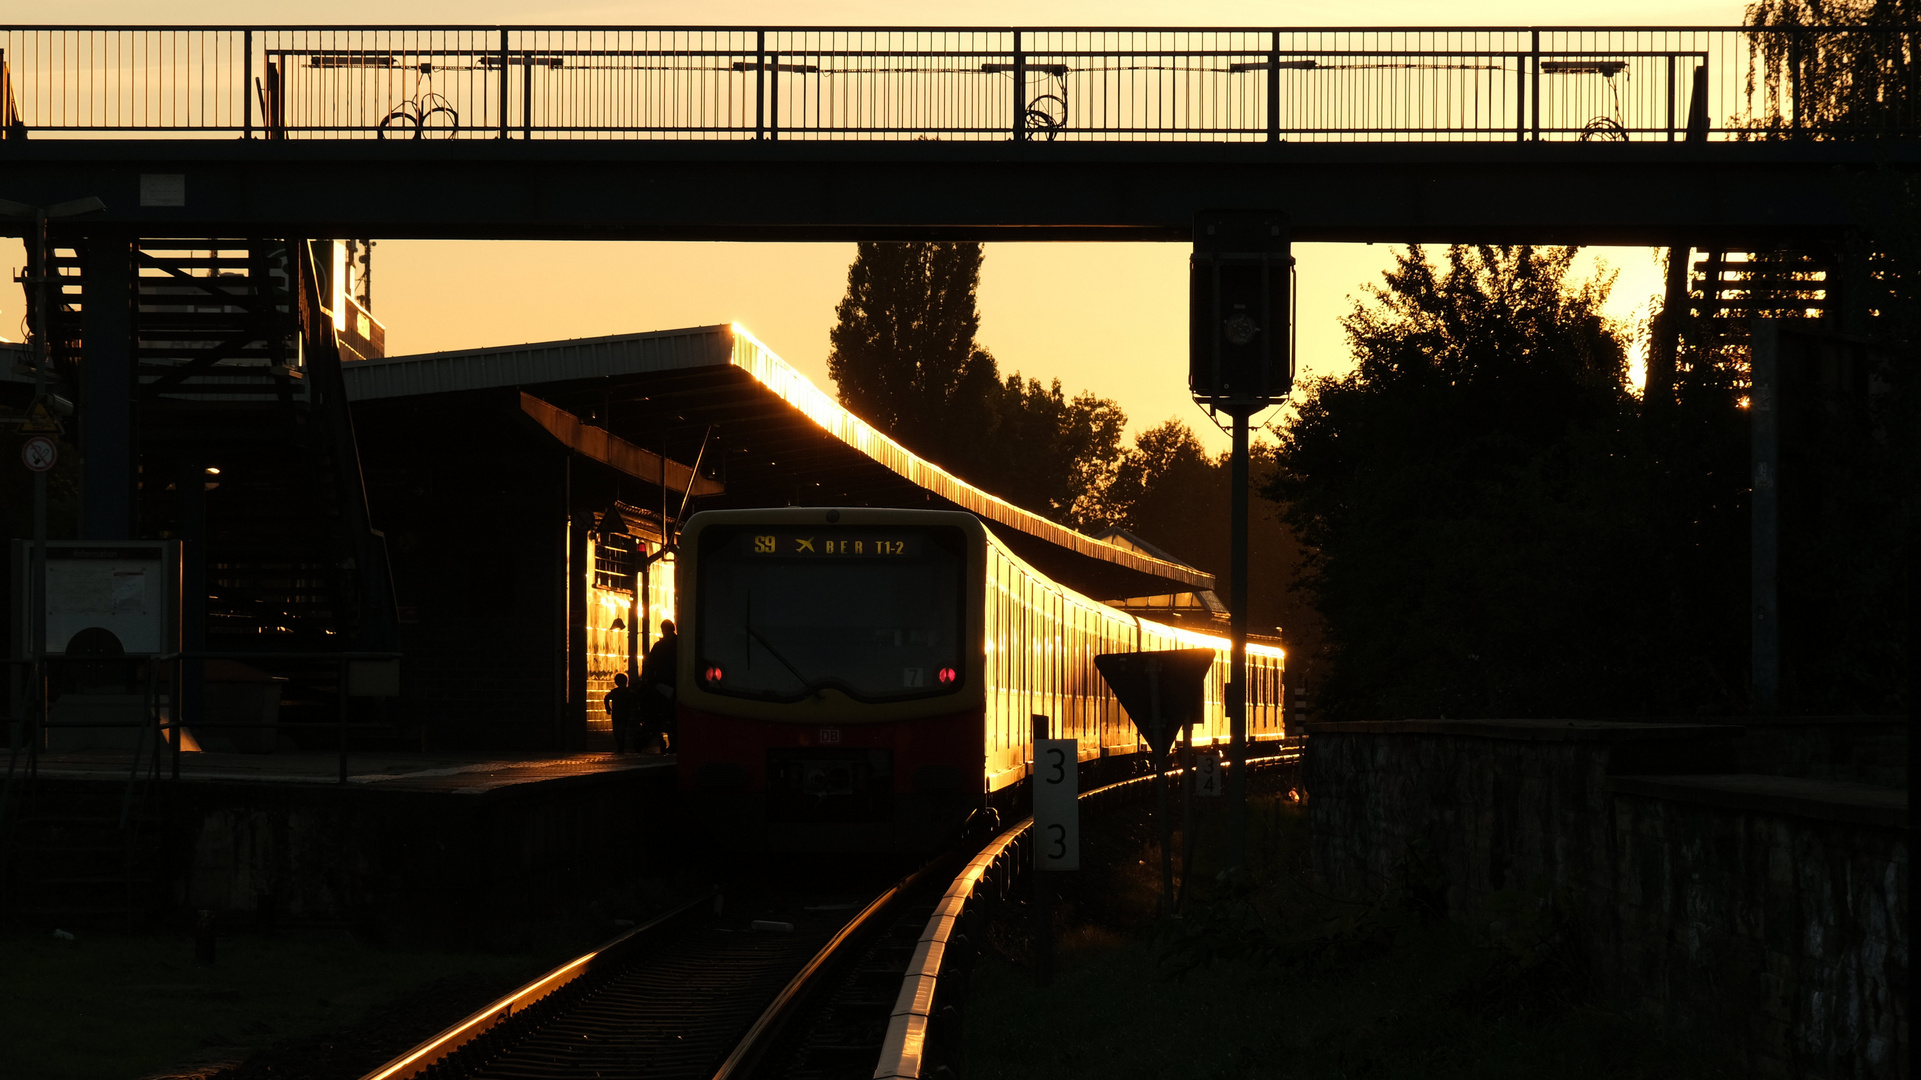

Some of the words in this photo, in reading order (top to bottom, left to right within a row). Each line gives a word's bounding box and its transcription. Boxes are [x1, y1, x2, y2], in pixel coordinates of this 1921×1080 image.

[74, 549, 118, 558] Information
[754, 535, 776, 554] S9
[876, 540, 904, 555] T1-2
[908, 669, 918, 686] 7
[820, 729, 840, 742] DB
[1046, 748, 1066, 785] 3
[1203, 757, 1214, 774] 3
[1203, 776, 1214, 793] 4
[1047, 823, 1067, 860] 3
